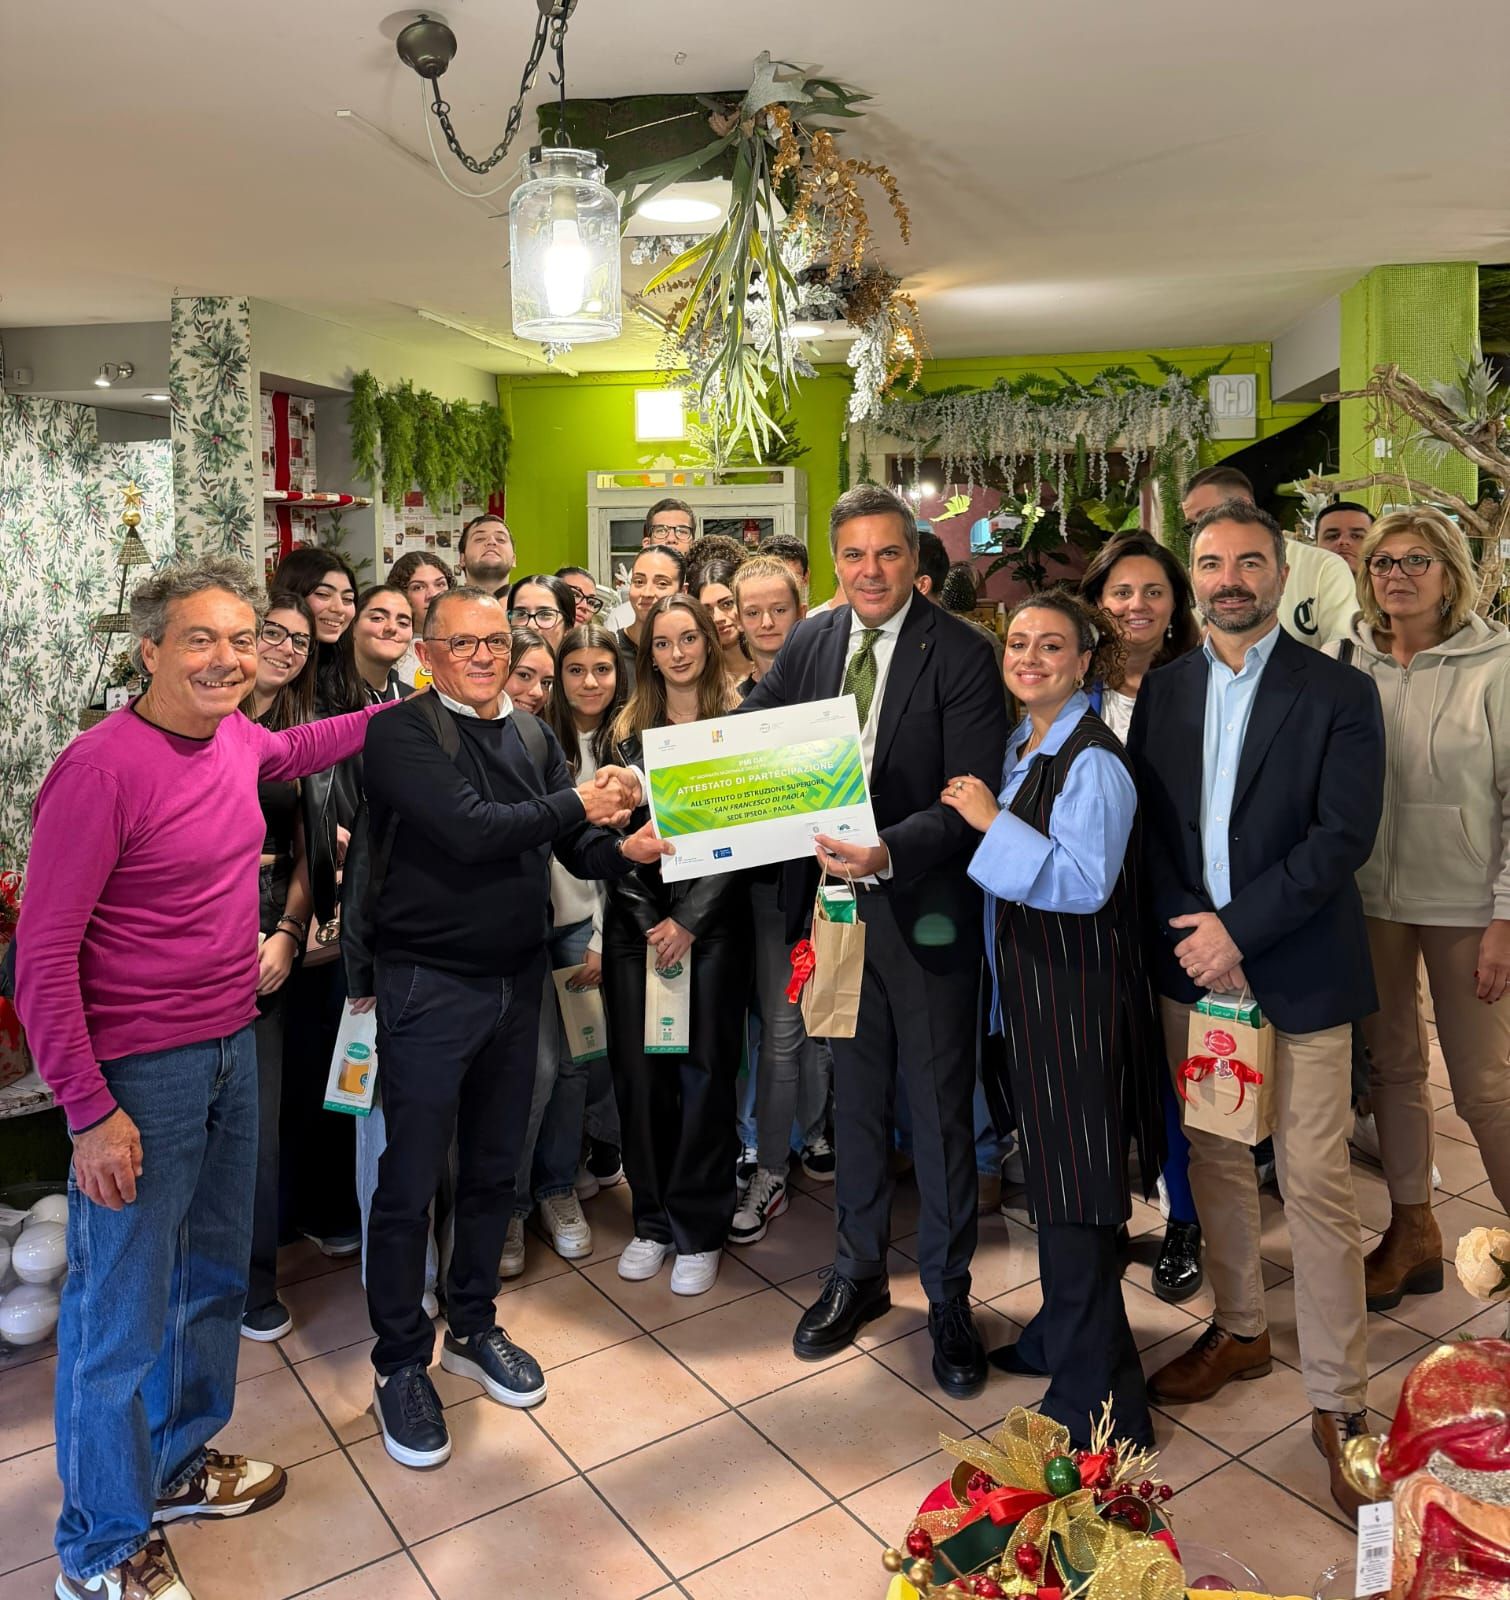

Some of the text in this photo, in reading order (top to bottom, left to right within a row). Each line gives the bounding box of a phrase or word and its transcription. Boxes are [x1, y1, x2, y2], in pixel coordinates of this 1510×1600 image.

[677, 779, 733, 795] ATTESTATO
[735, 776, 746, 785] DI
[748, 760, 834, 782] PARTECIPAZIONE
[730, 797, 771, 811] FRANCESCO
[772, 795, 780, 803] DI
[727, 812, 743, 821] SEDE
[773, 804, 796, 813] PAOLA
